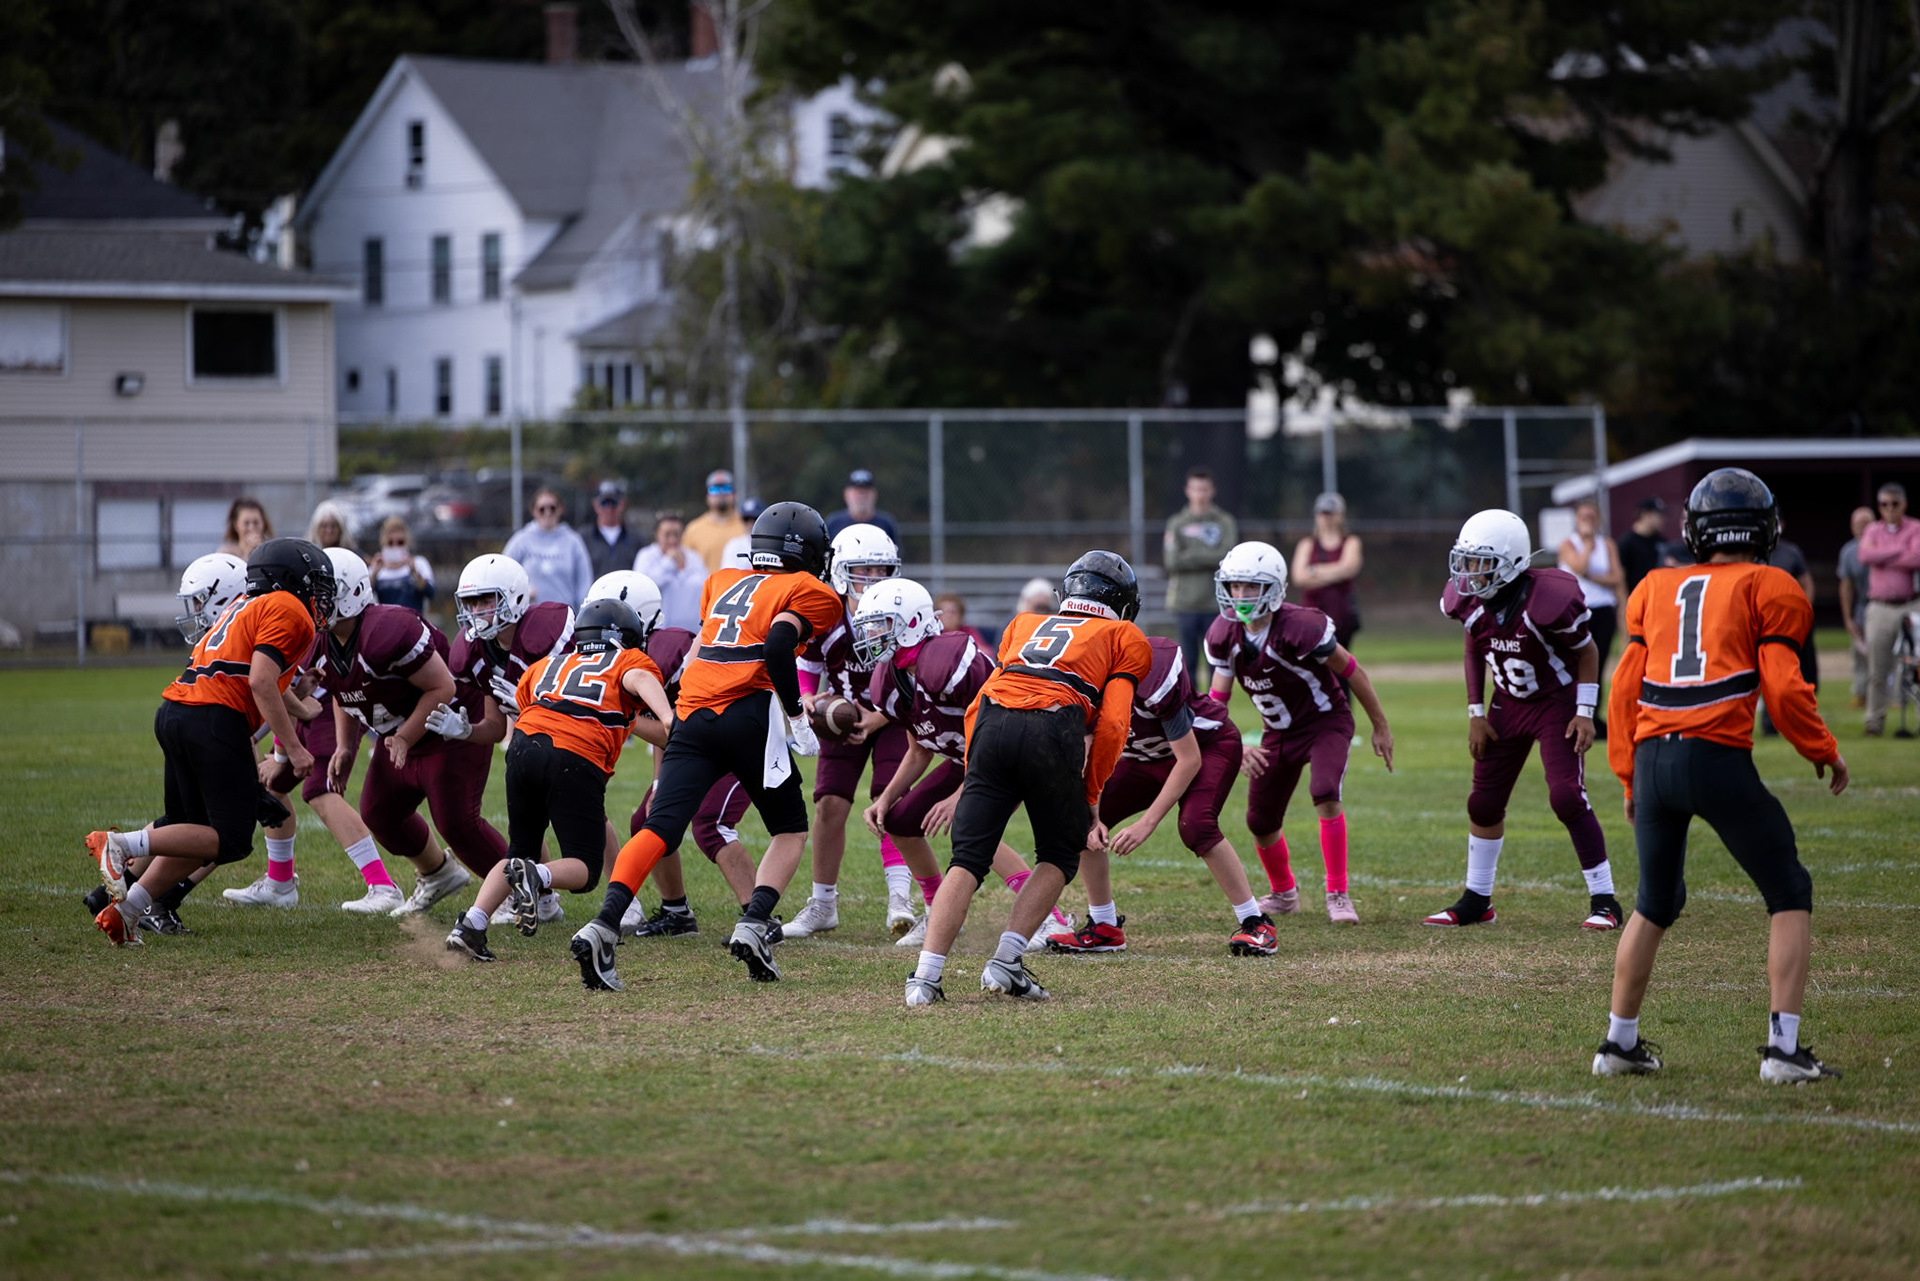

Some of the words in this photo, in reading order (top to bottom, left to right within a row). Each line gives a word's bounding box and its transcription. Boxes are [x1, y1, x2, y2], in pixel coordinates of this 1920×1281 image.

[1716, 531, 1750, 543] schutt
[755, 555, 779, 564] schutt
[709, 573, 772, 645] 4
[1067, 601, 1105, 616] Riddell
[1671, 574, 1711, 684] 1
[582, 643, 606, 651] schutt
[1018, 616, 1091, 669] 5
[1489, 637, 1521, 653] RAMS
[534, 649, 621, 706] 12
[1485, 651, 1539, 698] 19
[1243, 675, 1273, 691] RAMS
[340, 689, 367, 703] RAMS
[1251, 694, 1292, 729] 9
